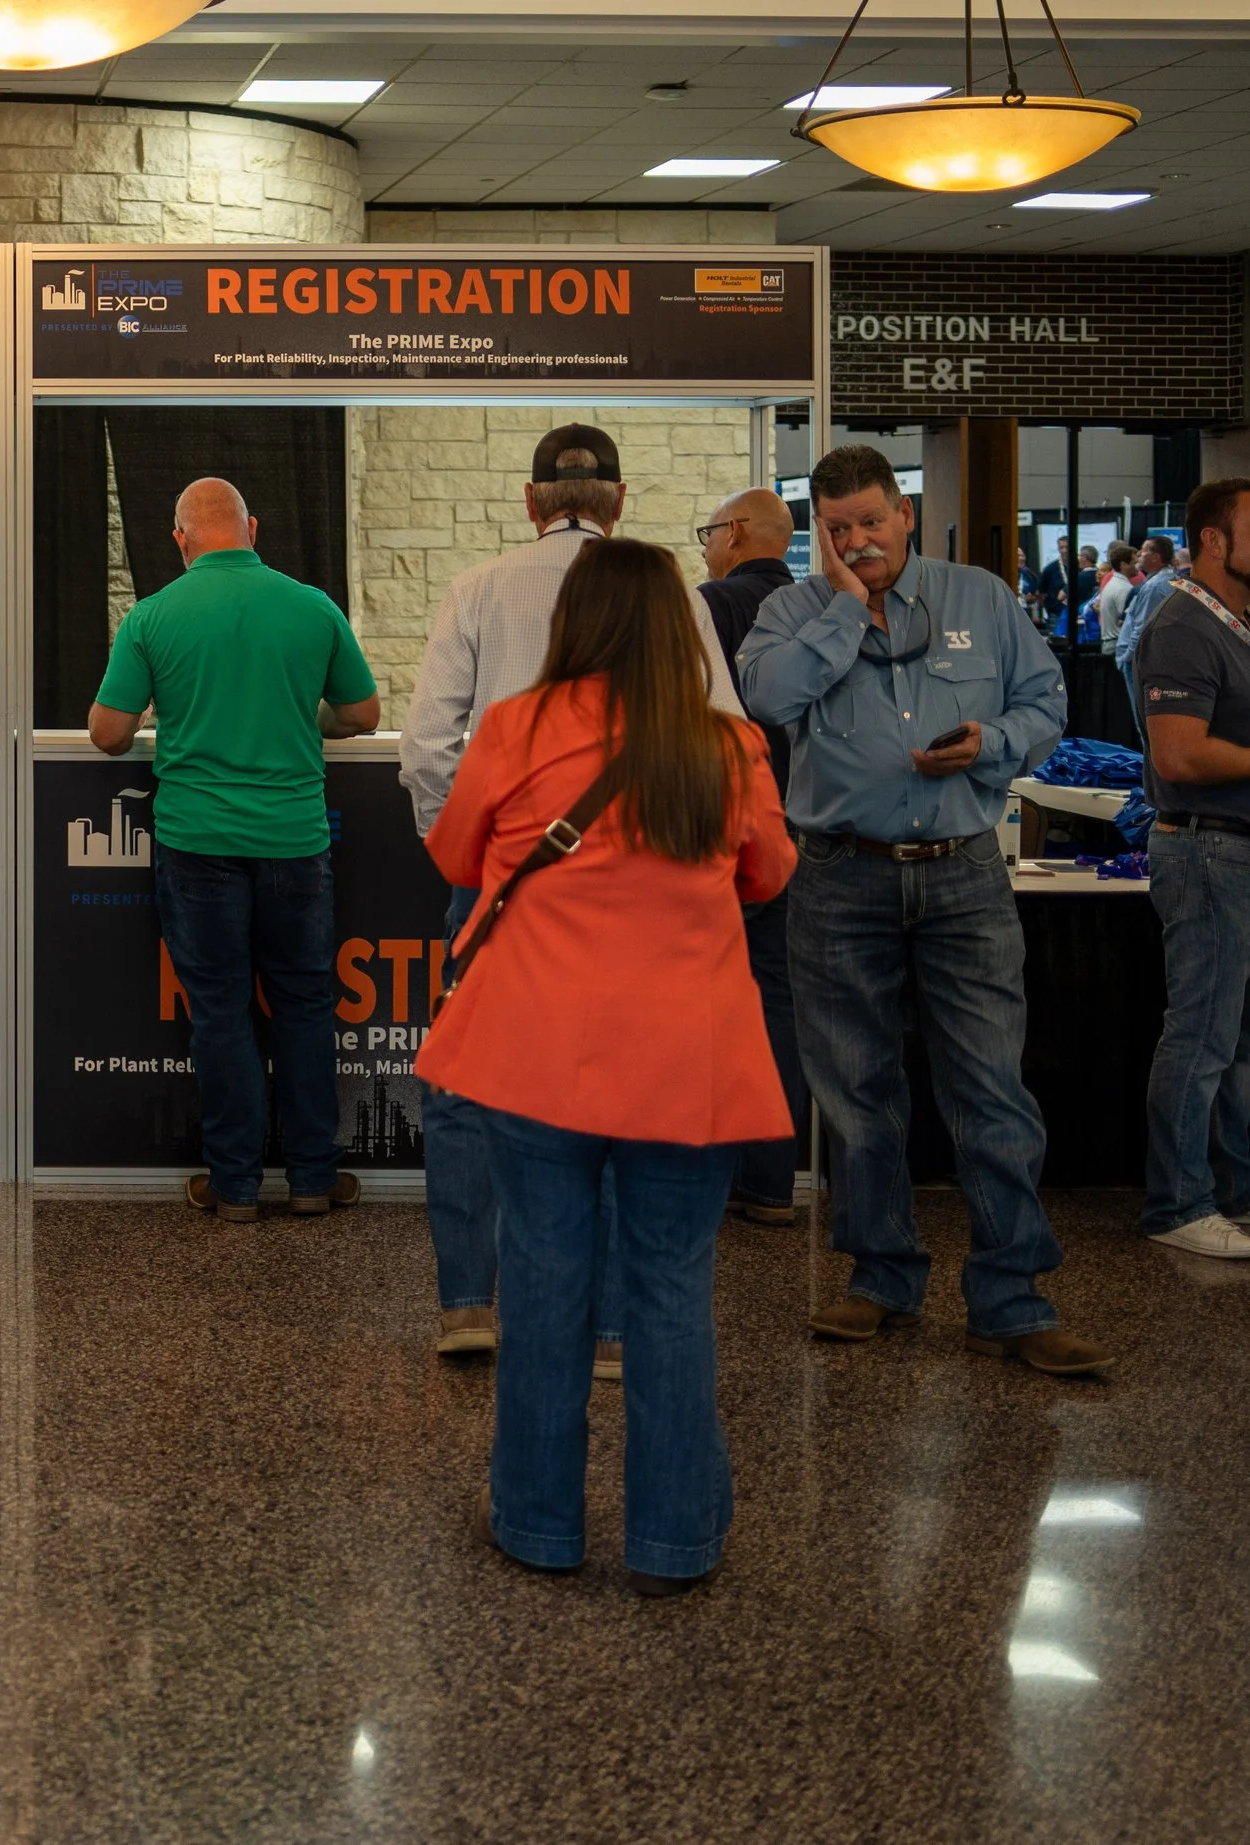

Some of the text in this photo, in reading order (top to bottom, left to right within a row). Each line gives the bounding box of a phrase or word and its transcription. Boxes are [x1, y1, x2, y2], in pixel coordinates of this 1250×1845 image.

[97, 270, 130, 279] THE
[762, 275, 781, 287] CAT
[97, 280, 183, 296] PRIME
[207, 268, 630, 315] REGISTRATION
[97, 296, 168, 311] EXPO
[699, 304, 784, 314] Registration Sponsor
[41, 323, 113, 332] PRESENTED BY
[119, 321, 141, 333] BIC
[142, 324, 188, 333] ALLIANCE
[830, 315, 1100, 343] POSITION HALL
[348, 333, 494, 352] The PRIME Expo
[214, 353, 628, 367] For Plant Reliability, Inspection, Maintenance and Engineering professionals
[903, 357, 987, 392] E&F
[71, 893, 156, 906] PRESENTE
[367, 1026, 432, 1051] PRI
[74, 1056, 105, 1072] For
[109, 1056, 159, 1073] Plant
